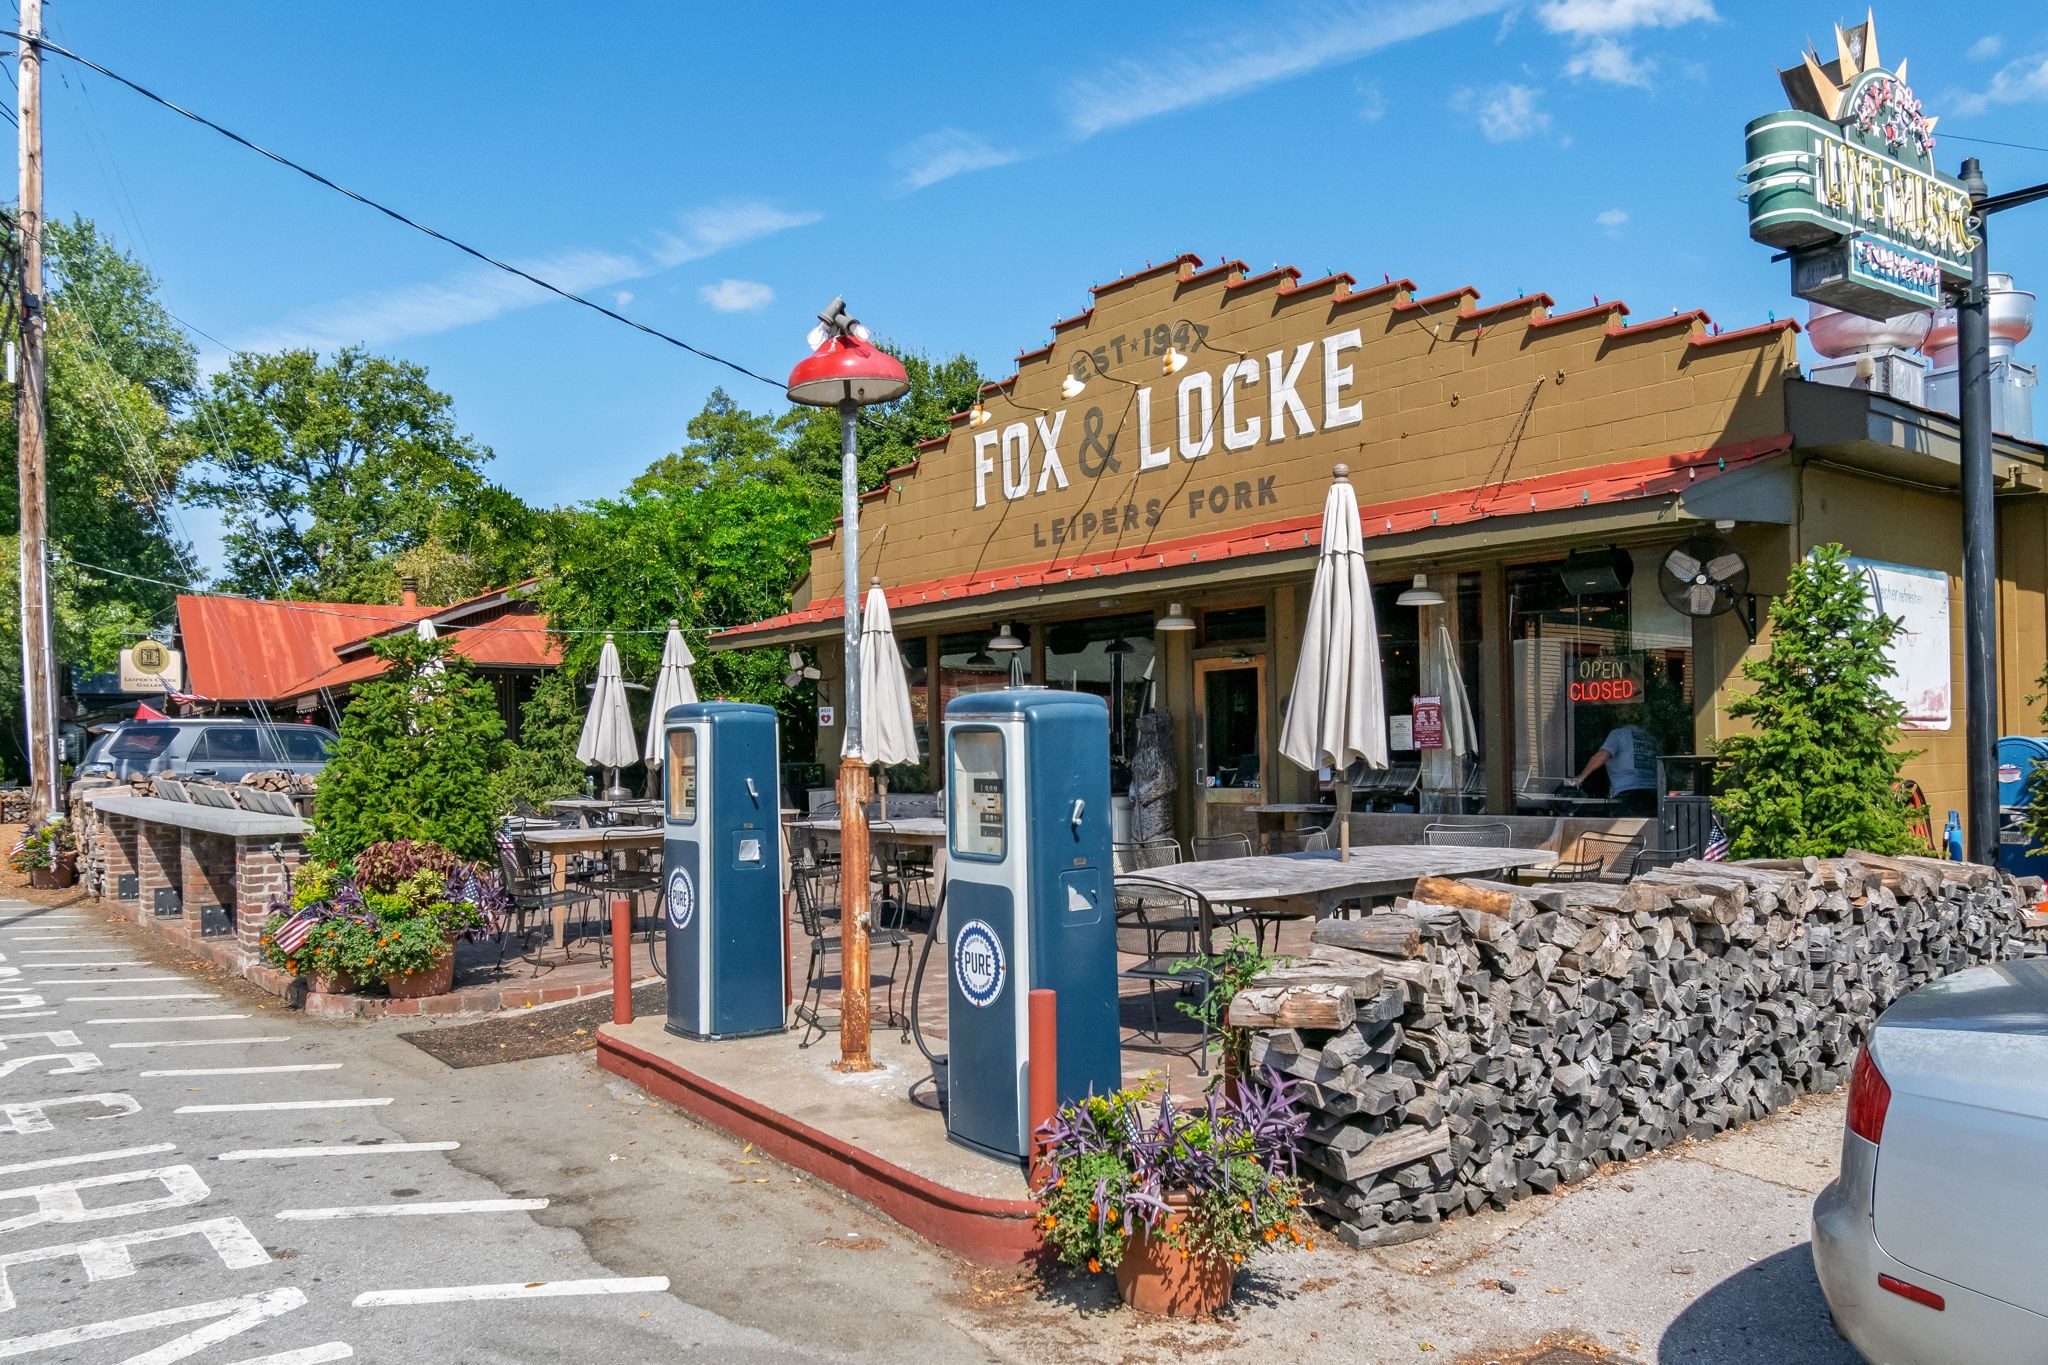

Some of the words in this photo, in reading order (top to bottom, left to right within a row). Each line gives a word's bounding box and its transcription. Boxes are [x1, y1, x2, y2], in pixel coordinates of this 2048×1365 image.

[1073, 334, 1127, 381] EST
[974, 410, 1068, 508] FOX
[1079, 406, 1122, 479] &
[1138, 328, 1363, 470] LOCKE
[1034, 498, 1161, 548] LEIPERS
[1189, 475, 1279, 519] FORK
[1580, 660, 1623, 679] OPEN
[1569, 680, 1633, 701] CLOSED
[673, 889, 687, 907] PURE
[965, 951, 991, 976] PURE
